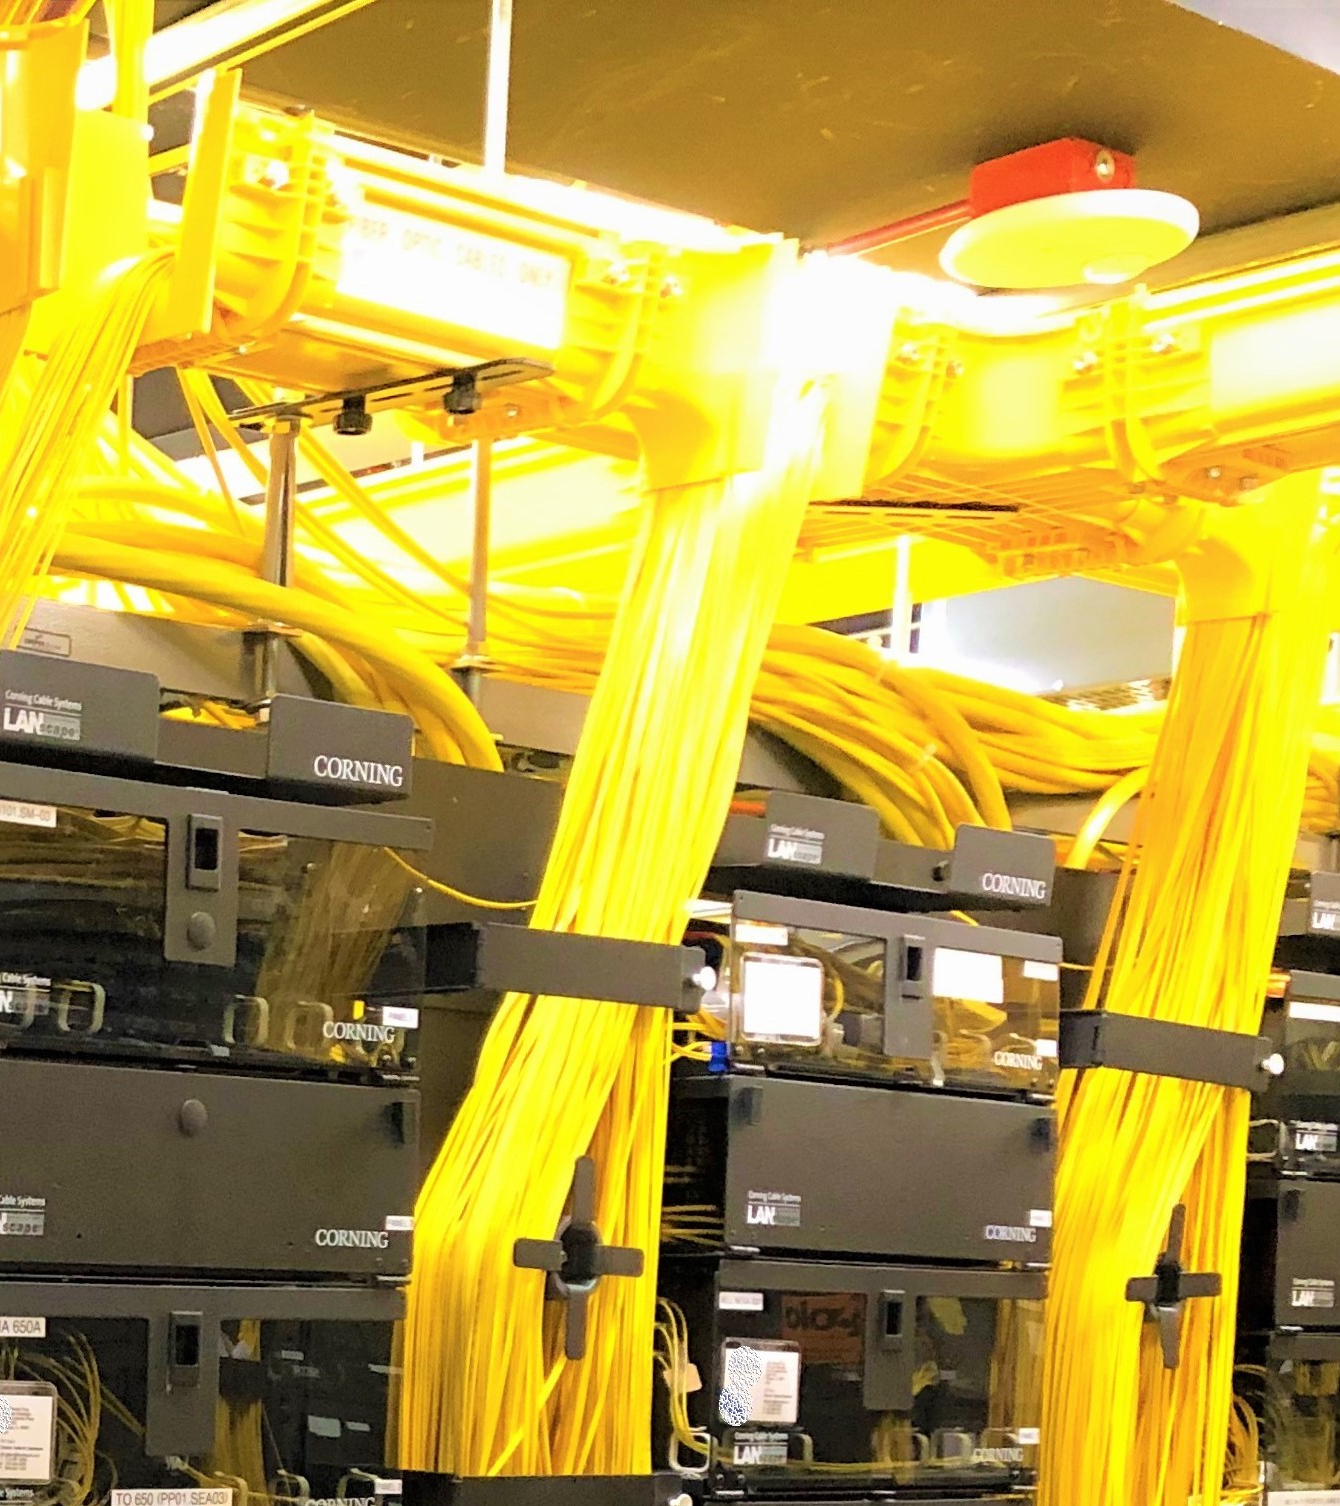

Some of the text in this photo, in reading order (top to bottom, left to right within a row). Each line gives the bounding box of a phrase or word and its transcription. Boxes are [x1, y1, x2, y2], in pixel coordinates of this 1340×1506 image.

[314, 755, 403, 787] CORNING
[982, 872, 1046, 899] CORNING
[322, 1020, 396, 1044] CORNING
[994, 1051, 1043, 1070] CORNING
[18, 1196, 46, 1208] Systems
[314, 1228, 389, 1249] CORNING
[985, 1224, 1037, 1243] CORNING
[13, 1320, 41, 1334] 650A
[5, 1487, 34, 1499] Systems
[116, 1492, 133, 1506] TO
[135, 1492, 154, 1506] 650
